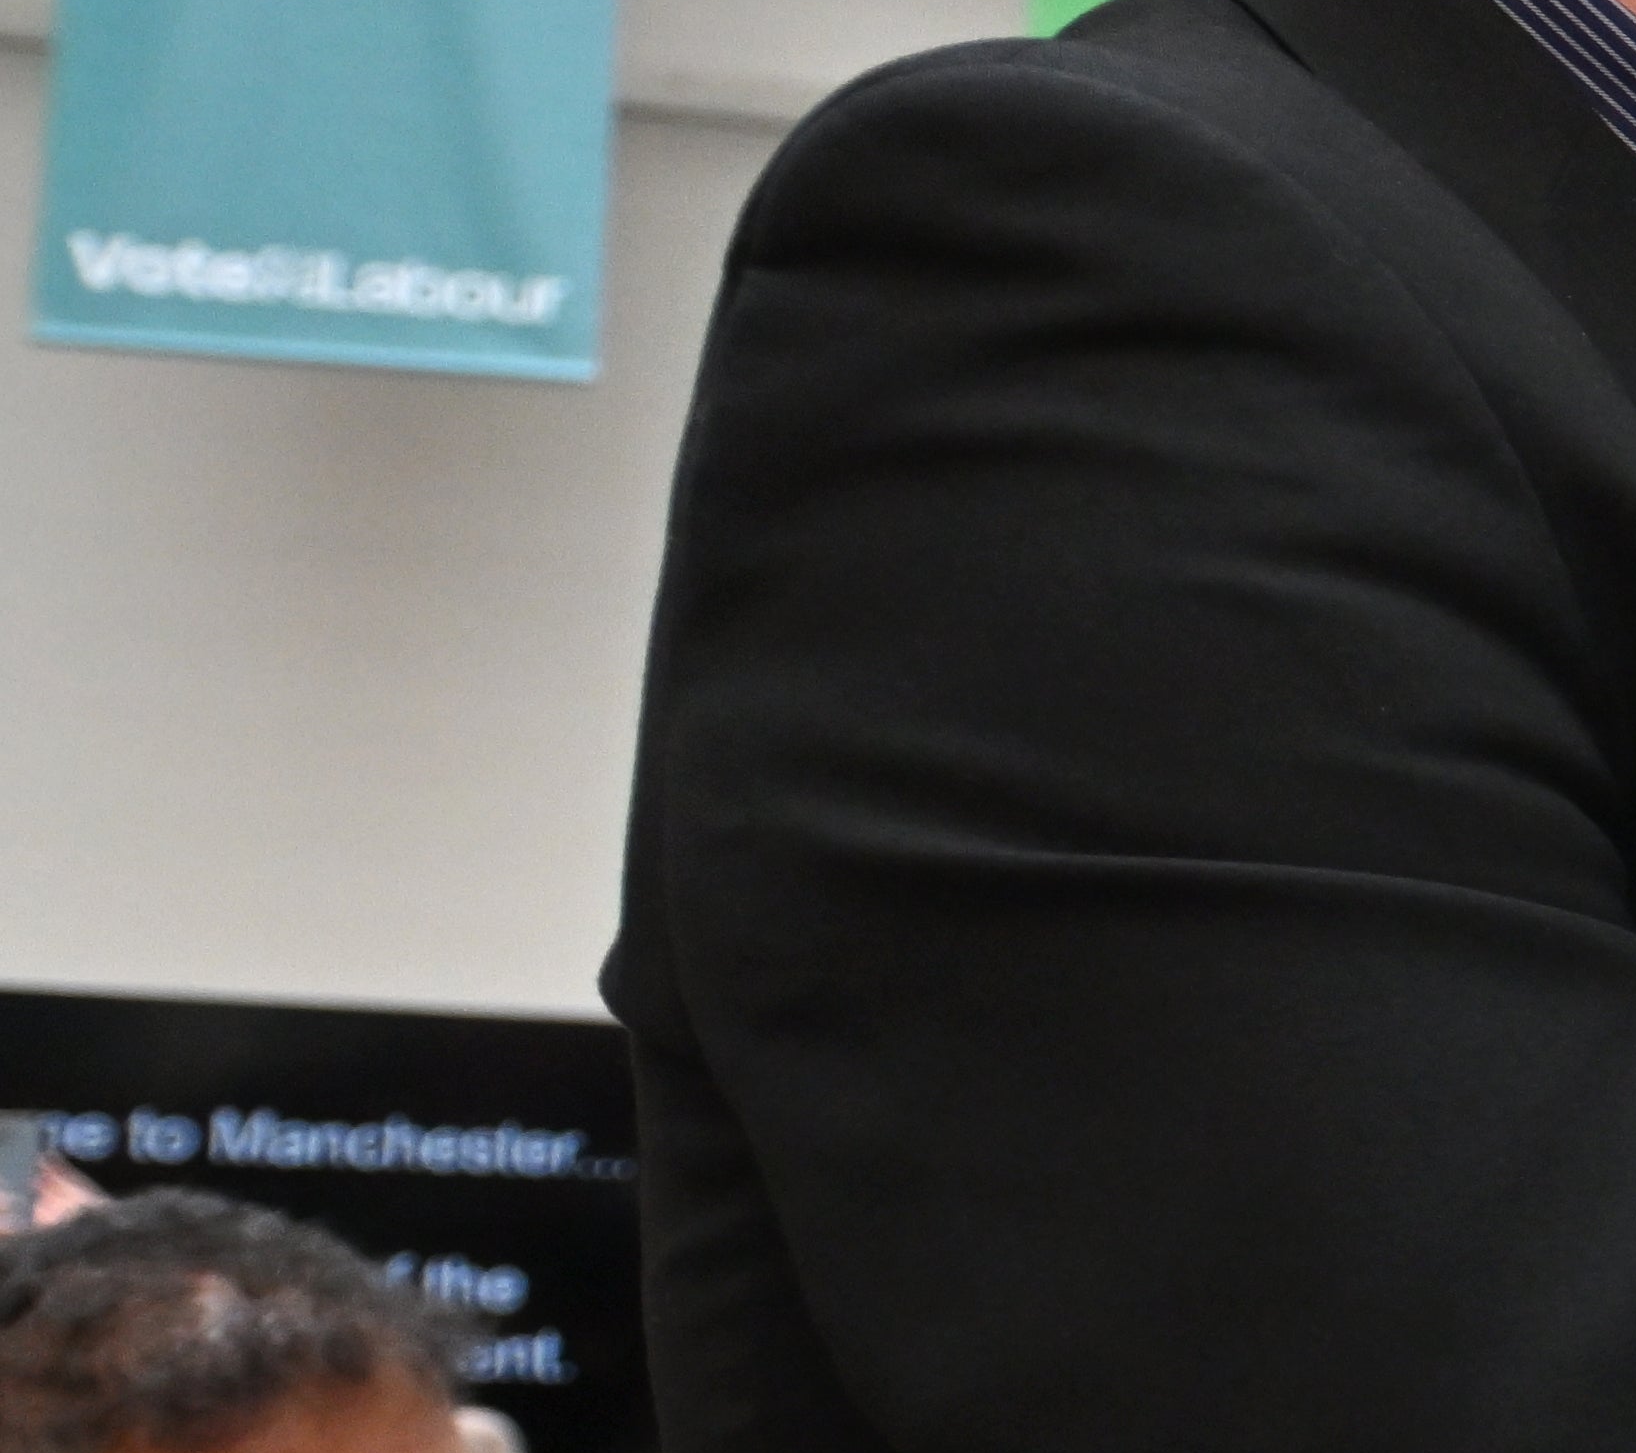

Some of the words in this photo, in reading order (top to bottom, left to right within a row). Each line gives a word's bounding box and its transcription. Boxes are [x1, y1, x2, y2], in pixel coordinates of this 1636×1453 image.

[66, 228, 249, 303] Vote
[305, 246, 567, 326] Labour
[127, 1105, 202, 1164] to
